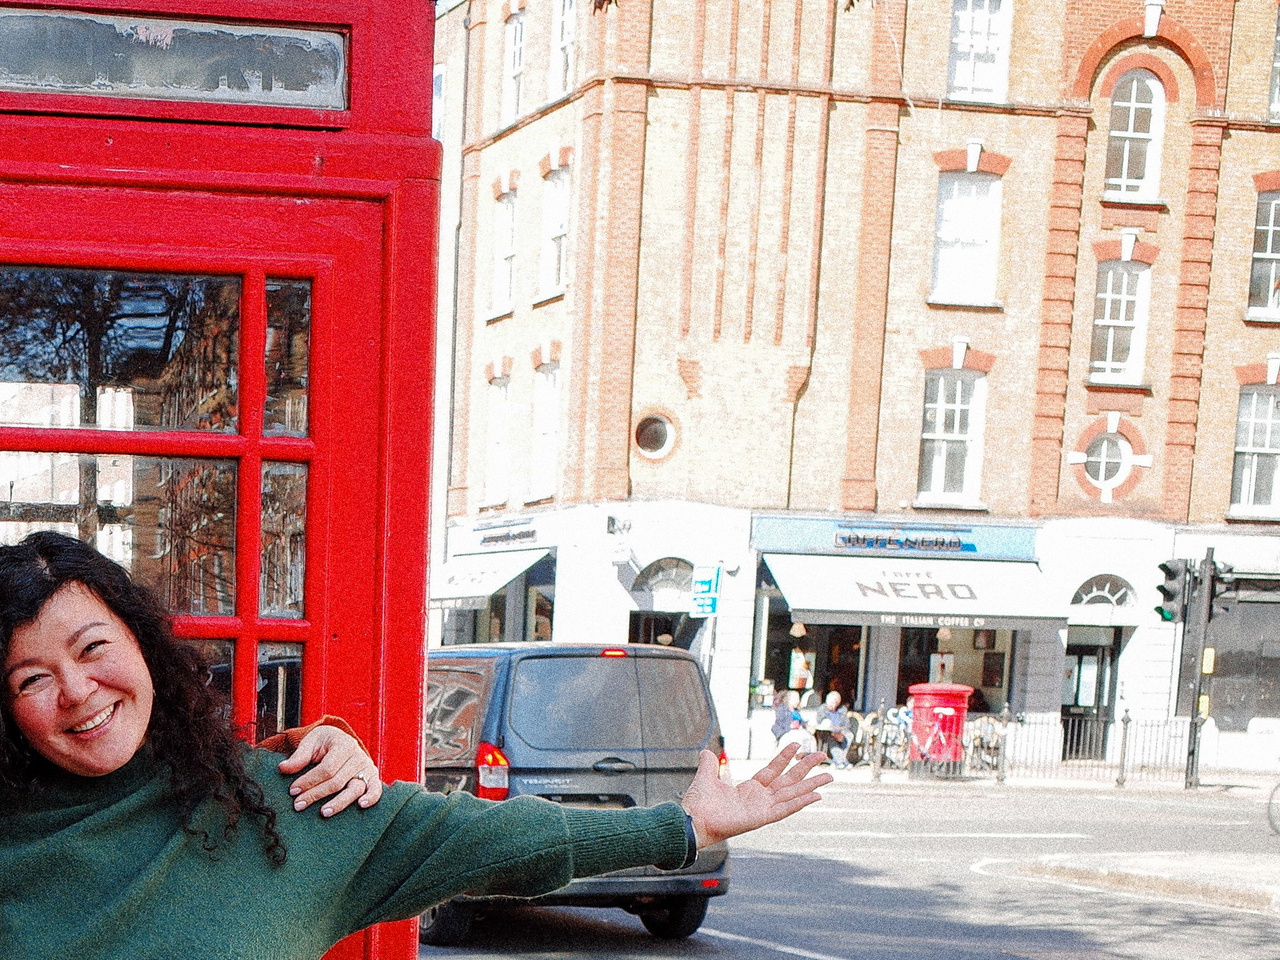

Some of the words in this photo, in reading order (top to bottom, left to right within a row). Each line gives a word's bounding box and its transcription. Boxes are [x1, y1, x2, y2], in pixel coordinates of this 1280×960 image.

[903, 537, 962, 551] NERO
[855, 581, 978, 600] NERO
[902, 615, 933, 626] ITALIAN
[938, 616, 969, 627] COFFEE
